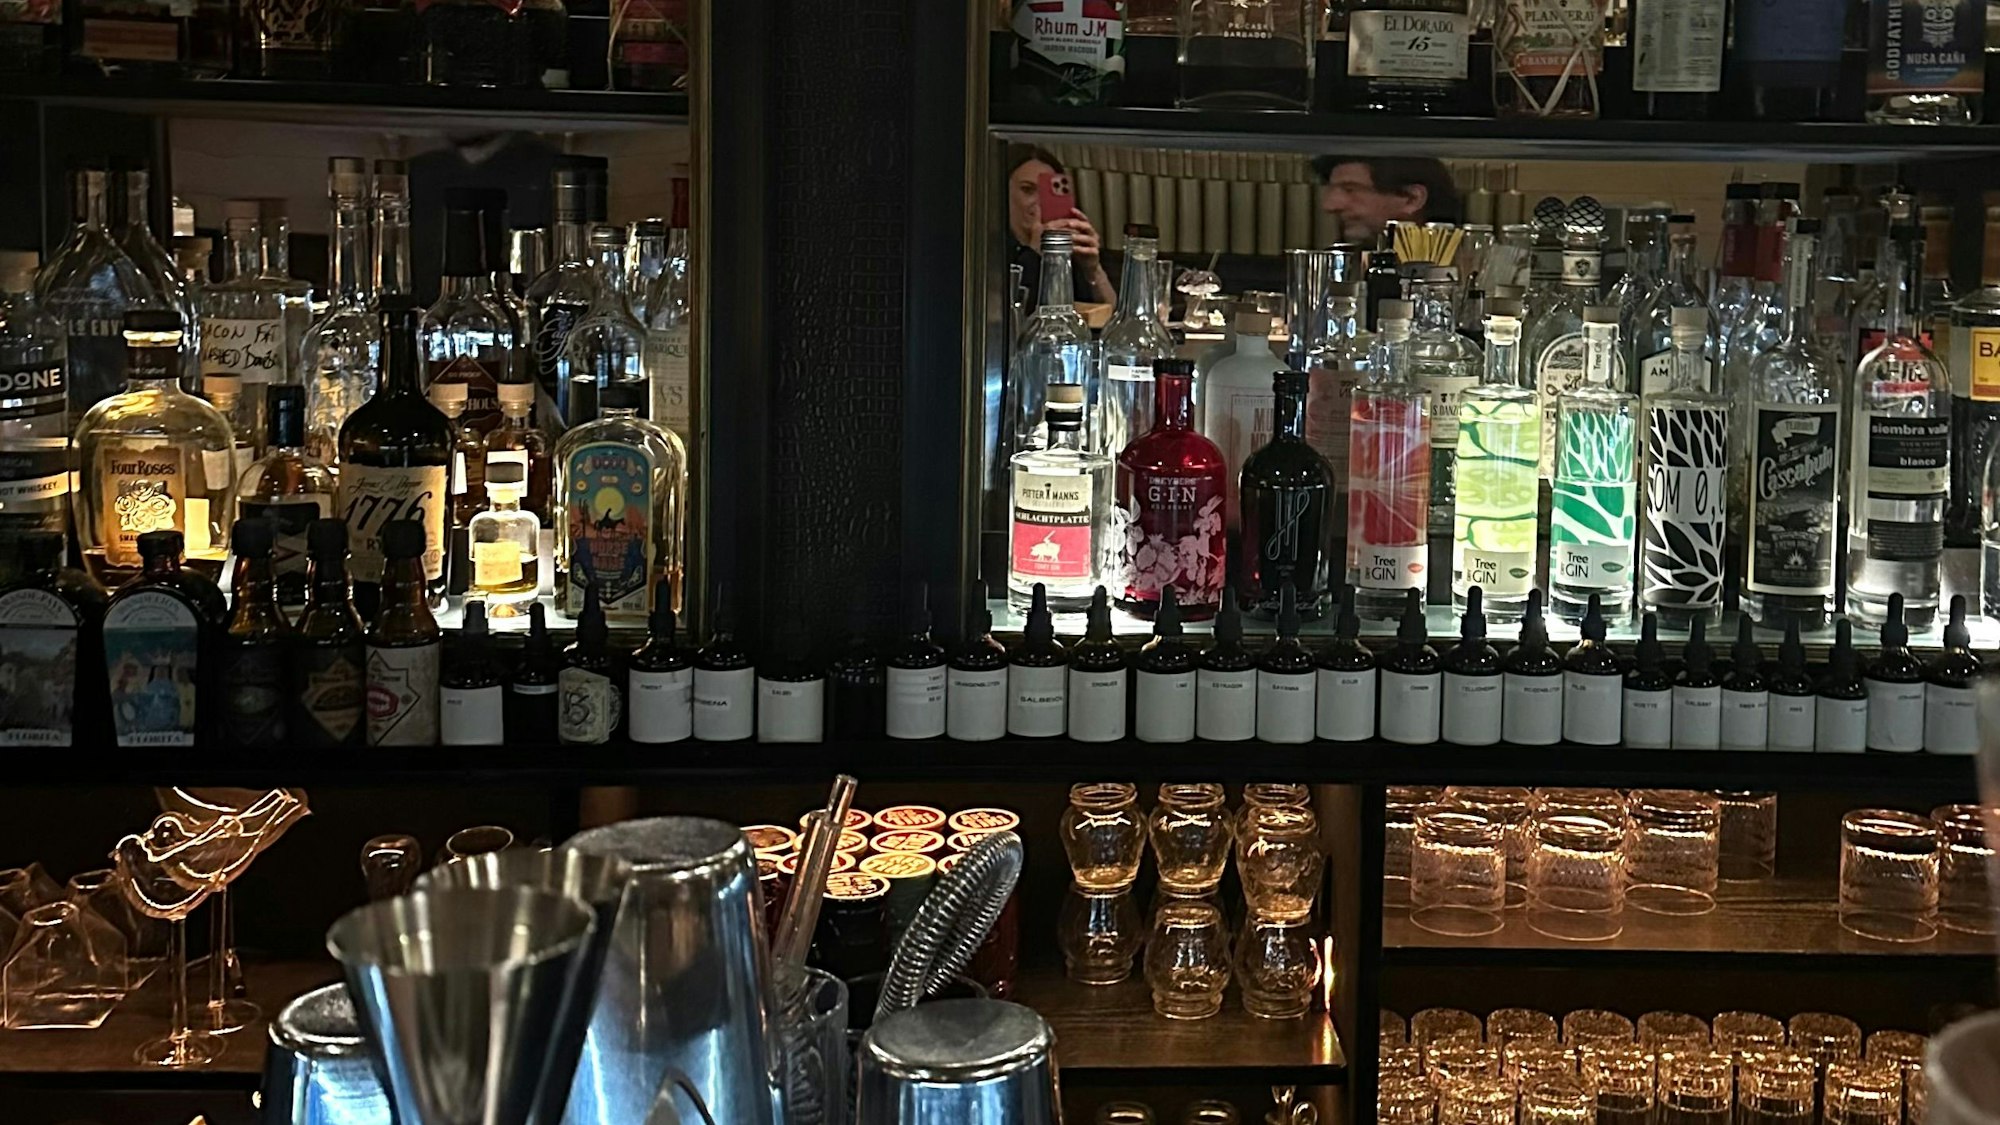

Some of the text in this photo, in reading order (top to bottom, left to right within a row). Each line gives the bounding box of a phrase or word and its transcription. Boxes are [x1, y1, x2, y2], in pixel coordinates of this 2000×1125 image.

[1525, 10, 1594, 21] PLANERA
[1034, 17, 1107, 37] Rhum J.M
[1403, 16, 1454, 33] DORADO
[1407, 36, 1431, 52] 15
[1906, 53, 1937, 65] NUSA
[467, 397, 499, 411] HOUS
[1872, 422, 1926, 435] siembra
[111, 460, 176, 476] Four Roses
[1899, 456, 1937, 466] blanco
[18, 481, 58, 495] WHISKEY
[1052, 490, 1079, 500] MANNS
[345, 490, 432, 536] 1776
[1014, 511, 1091, 524] SCHLACHTPLATTE
[1373, 555, 1396, 567] Tree
[1474, 557, 1497, 570] Tree
[1566, 551, 1589, 564] Tree
[1371, 566, 1396, 581] GIN
[1472, 570, 1497, 584] GIN
[1565, 563, 1589, 579] GIN
